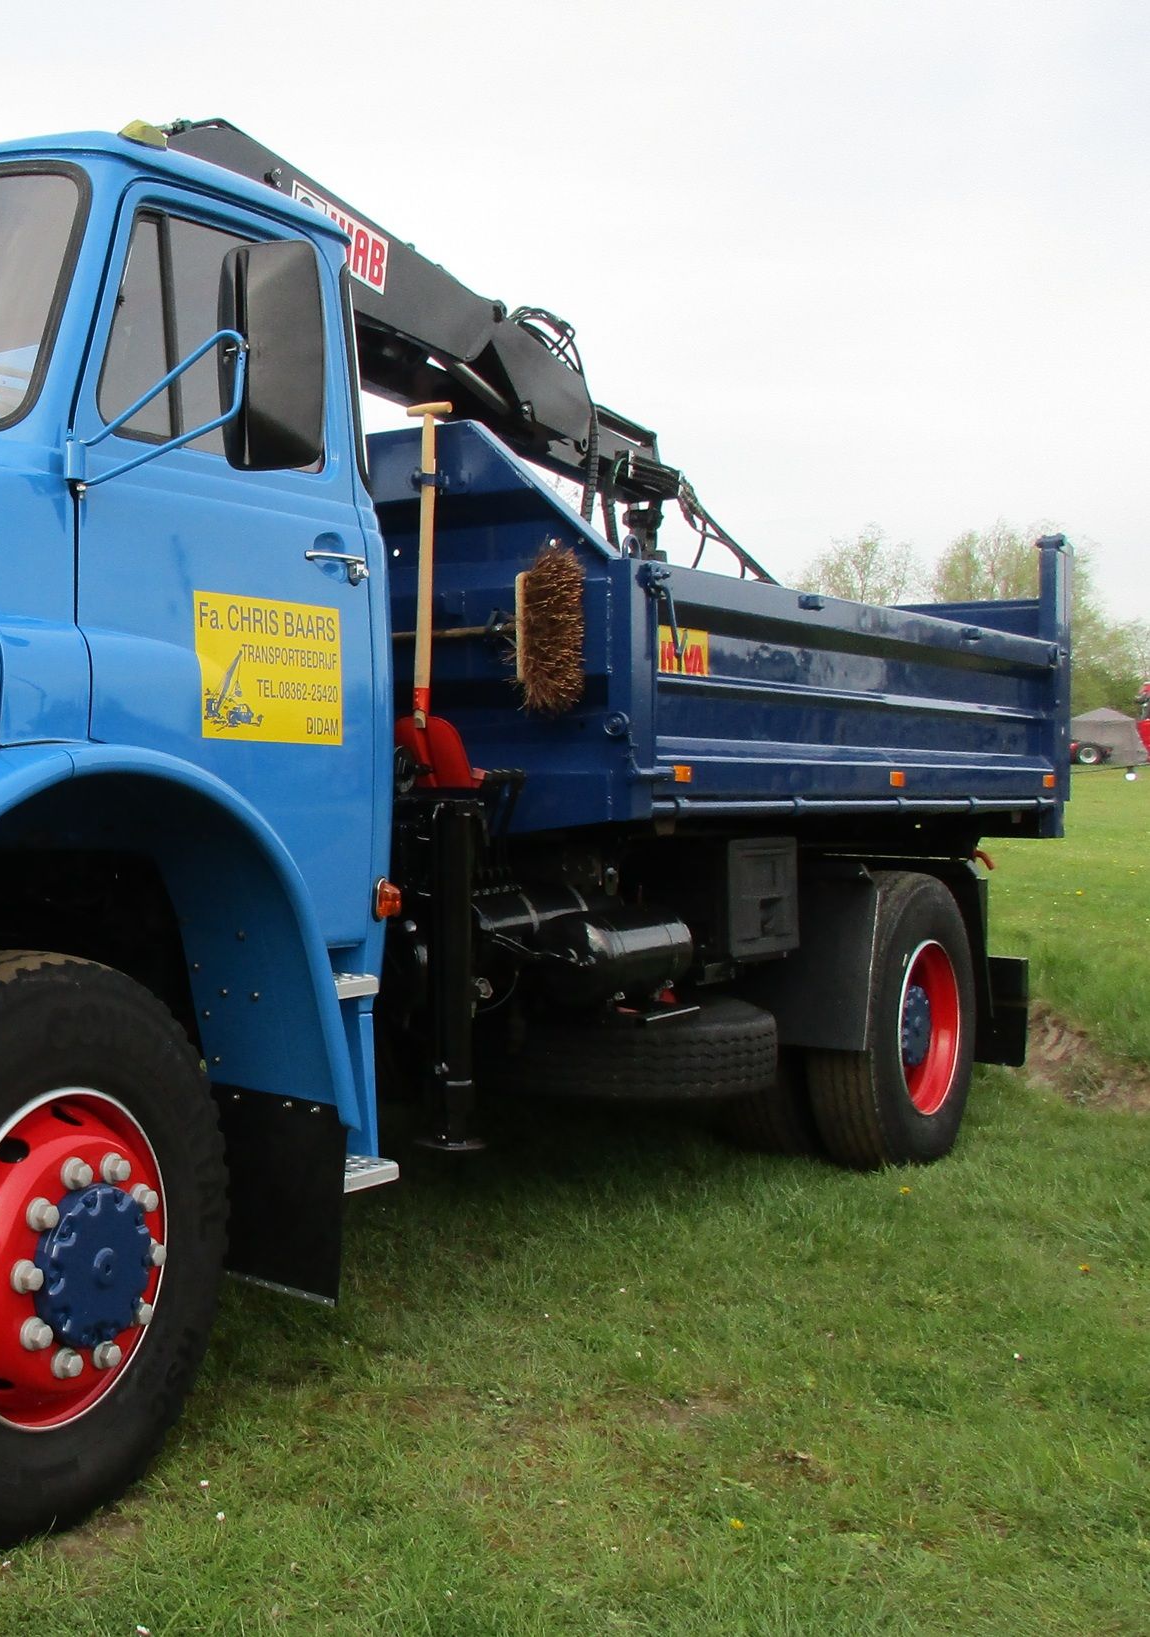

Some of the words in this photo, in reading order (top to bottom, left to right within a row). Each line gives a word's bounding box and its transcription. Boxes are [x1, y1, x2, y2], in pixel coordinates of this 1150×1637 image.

[199, 602, 223, 629] Fa.
[227, 604, 279, 636] CHRIS
[284, 612, 336, 642] BAARS
[241, 644, 337, 670] TRANSPORTBEDRIJF
[660, 640, 705, 675] HVA
[306, 717, 339, 736] DIDAM
